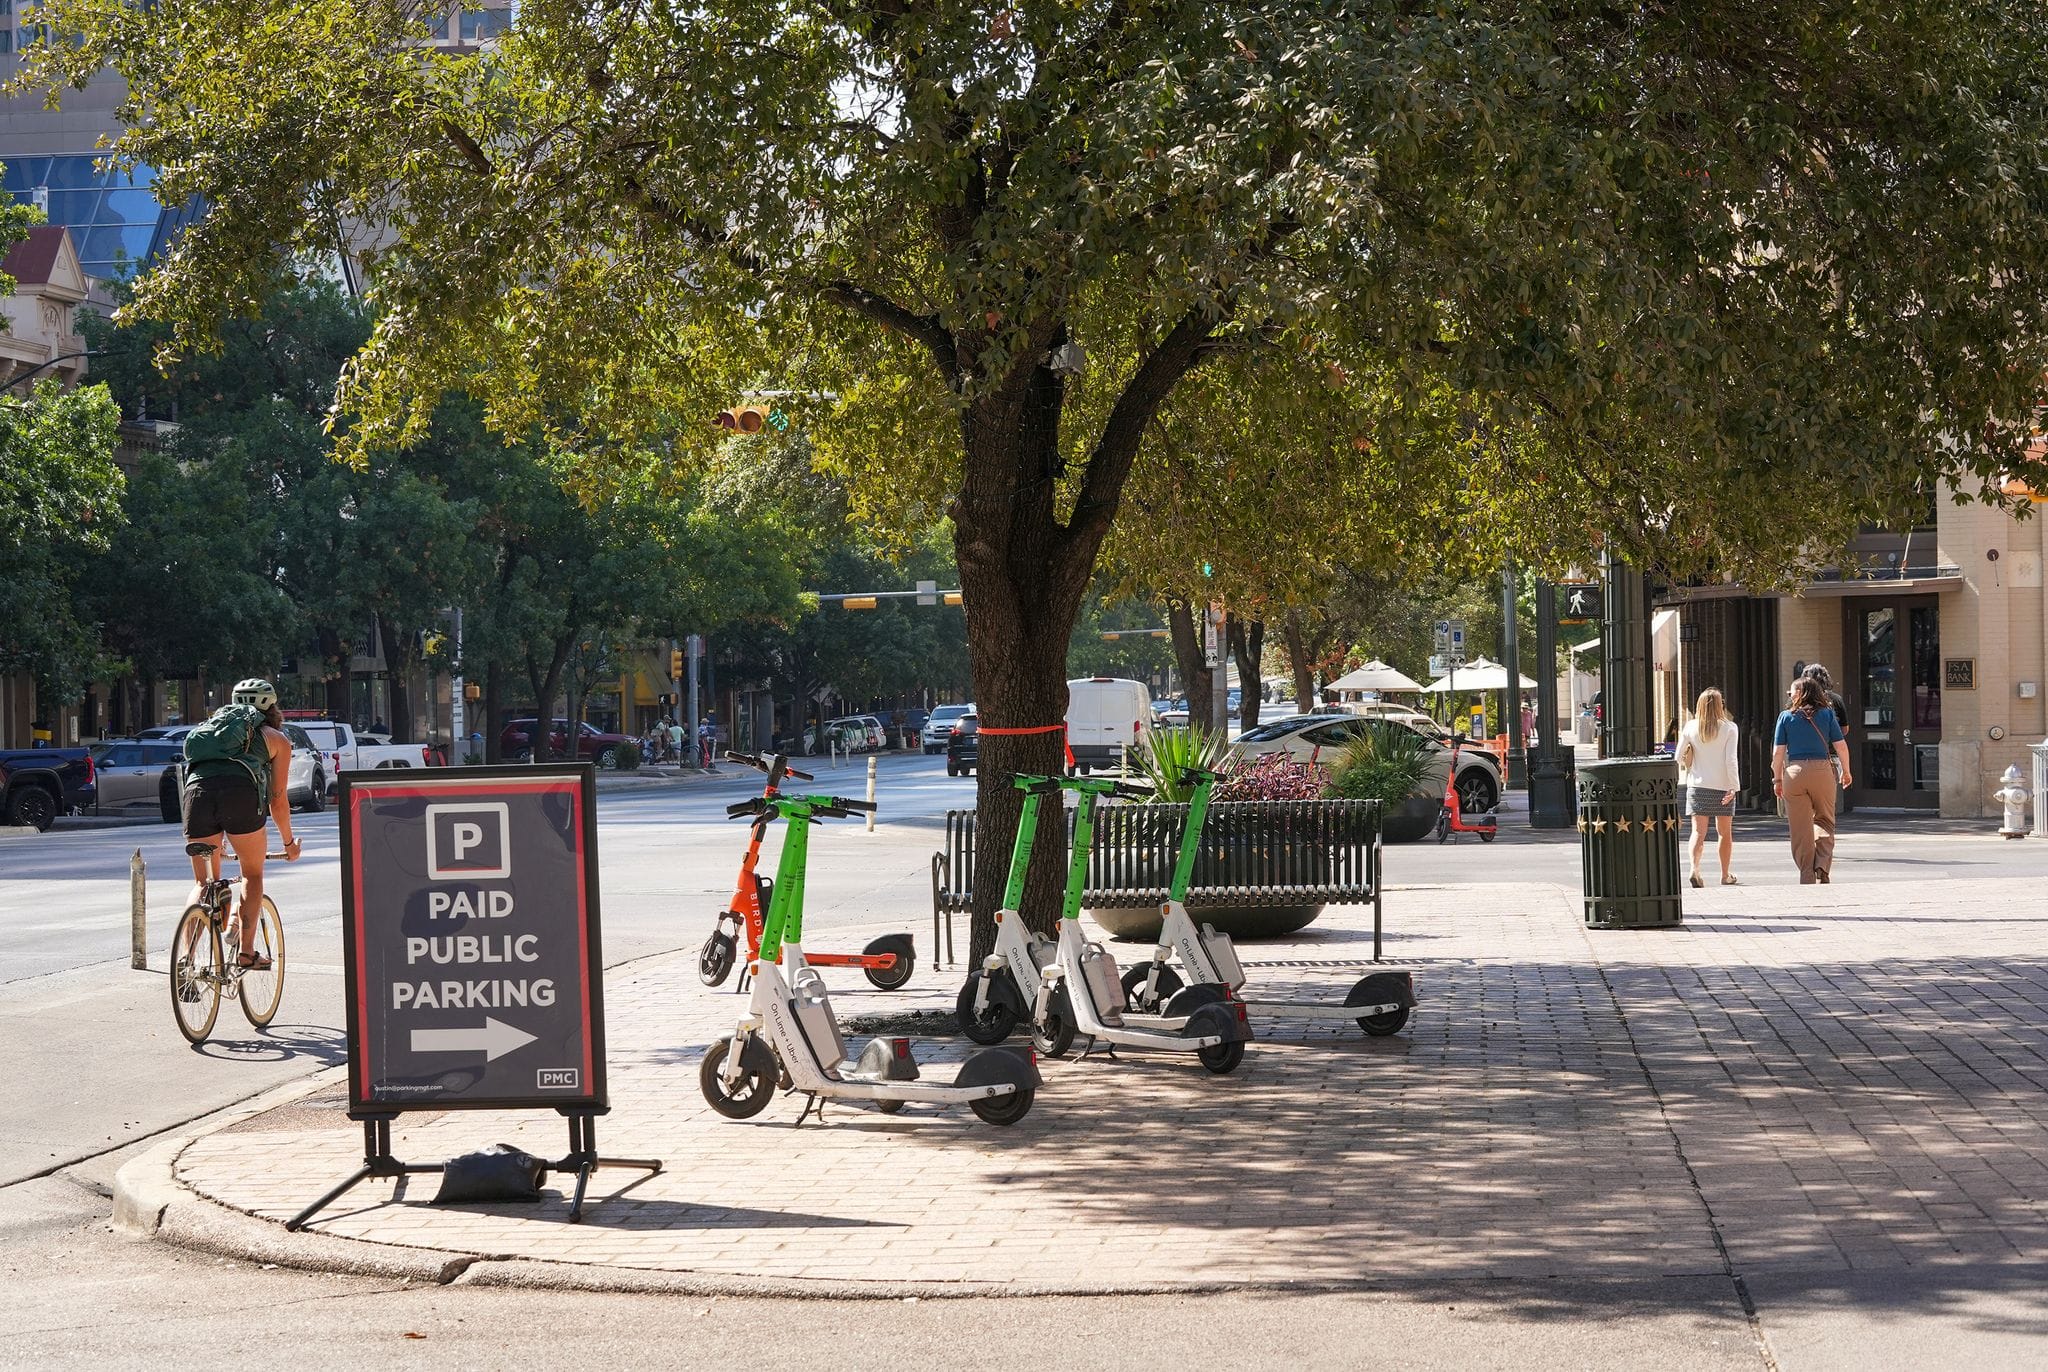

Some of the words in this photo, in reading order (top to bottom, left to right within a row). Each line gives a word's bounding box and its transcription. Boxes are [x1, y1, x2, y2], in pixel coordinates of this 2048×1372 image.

[1947, 673, 1972, 682] BANK
[1473, 714, 1480, 723] P
[453, 822, 483, 861] P
[428, 890, 515, 920] PAID
[750, 892, 762, 927] BIRD
[406, 933, 540, 965] PUBLIC
[392, 978, 556, 1010] PARKING
[786, 1043, 799, 1064] Uber
[543, 1073, 573, 1084] PMC
